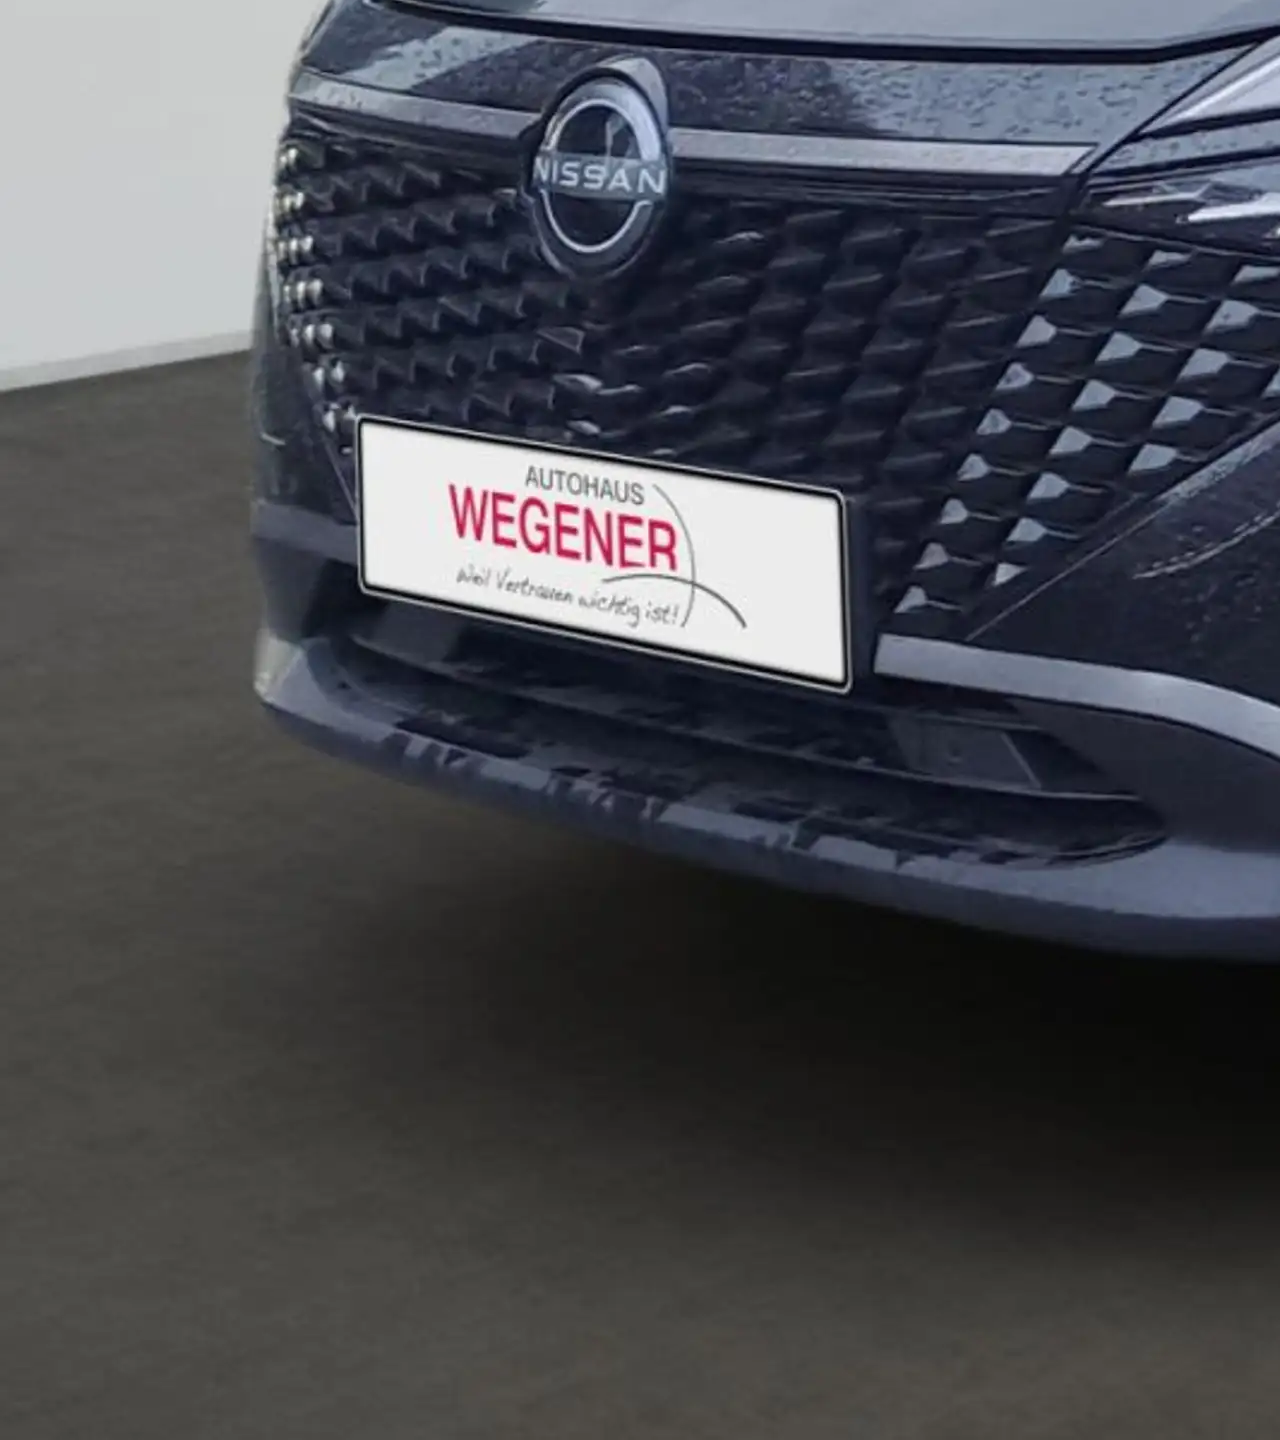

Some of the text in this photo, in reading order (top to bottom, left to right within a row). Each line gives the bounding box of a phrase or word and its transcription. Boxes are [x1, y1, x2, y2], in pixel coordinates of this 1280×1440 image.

[533, 156, 667, 194] NISSAN
[525, 464, 644, 506] AUTOHAUS
[448, 485, 678, 572] WEGENER
[496, 566, 574, 605] Vertrauen
